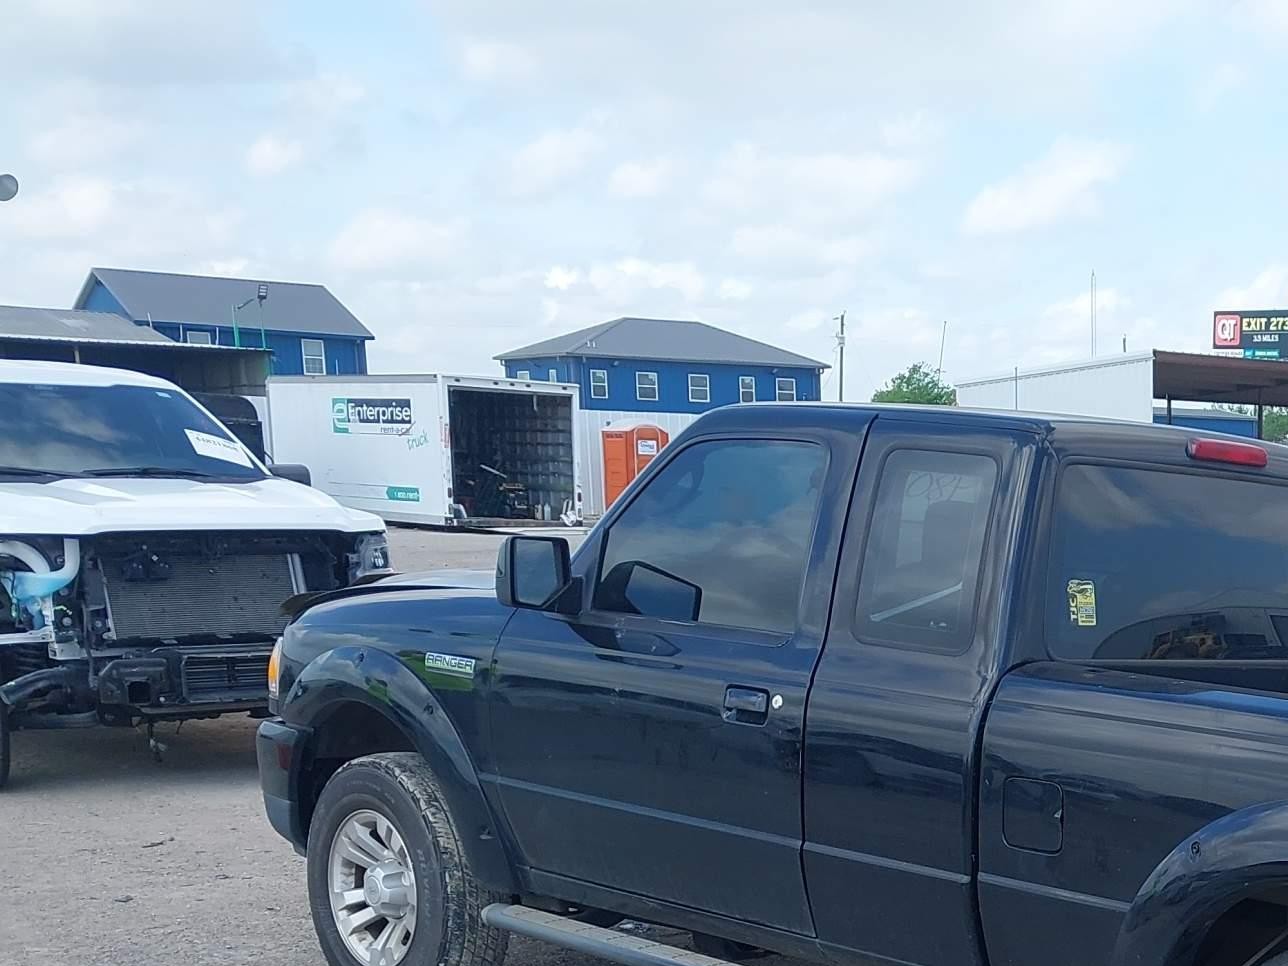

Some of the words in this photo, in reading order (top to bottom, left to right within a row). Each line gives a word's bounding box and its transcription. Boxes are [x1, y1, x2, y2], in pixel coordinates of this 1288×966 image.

[1217, 319, 1237, 341] QT
[1242, 318, 1267, 331] EXIT
[347, 402, 411, 424] Enterprise
[407, 429, 429, 450] truck
[427, 654, 473, 670] RANGER
